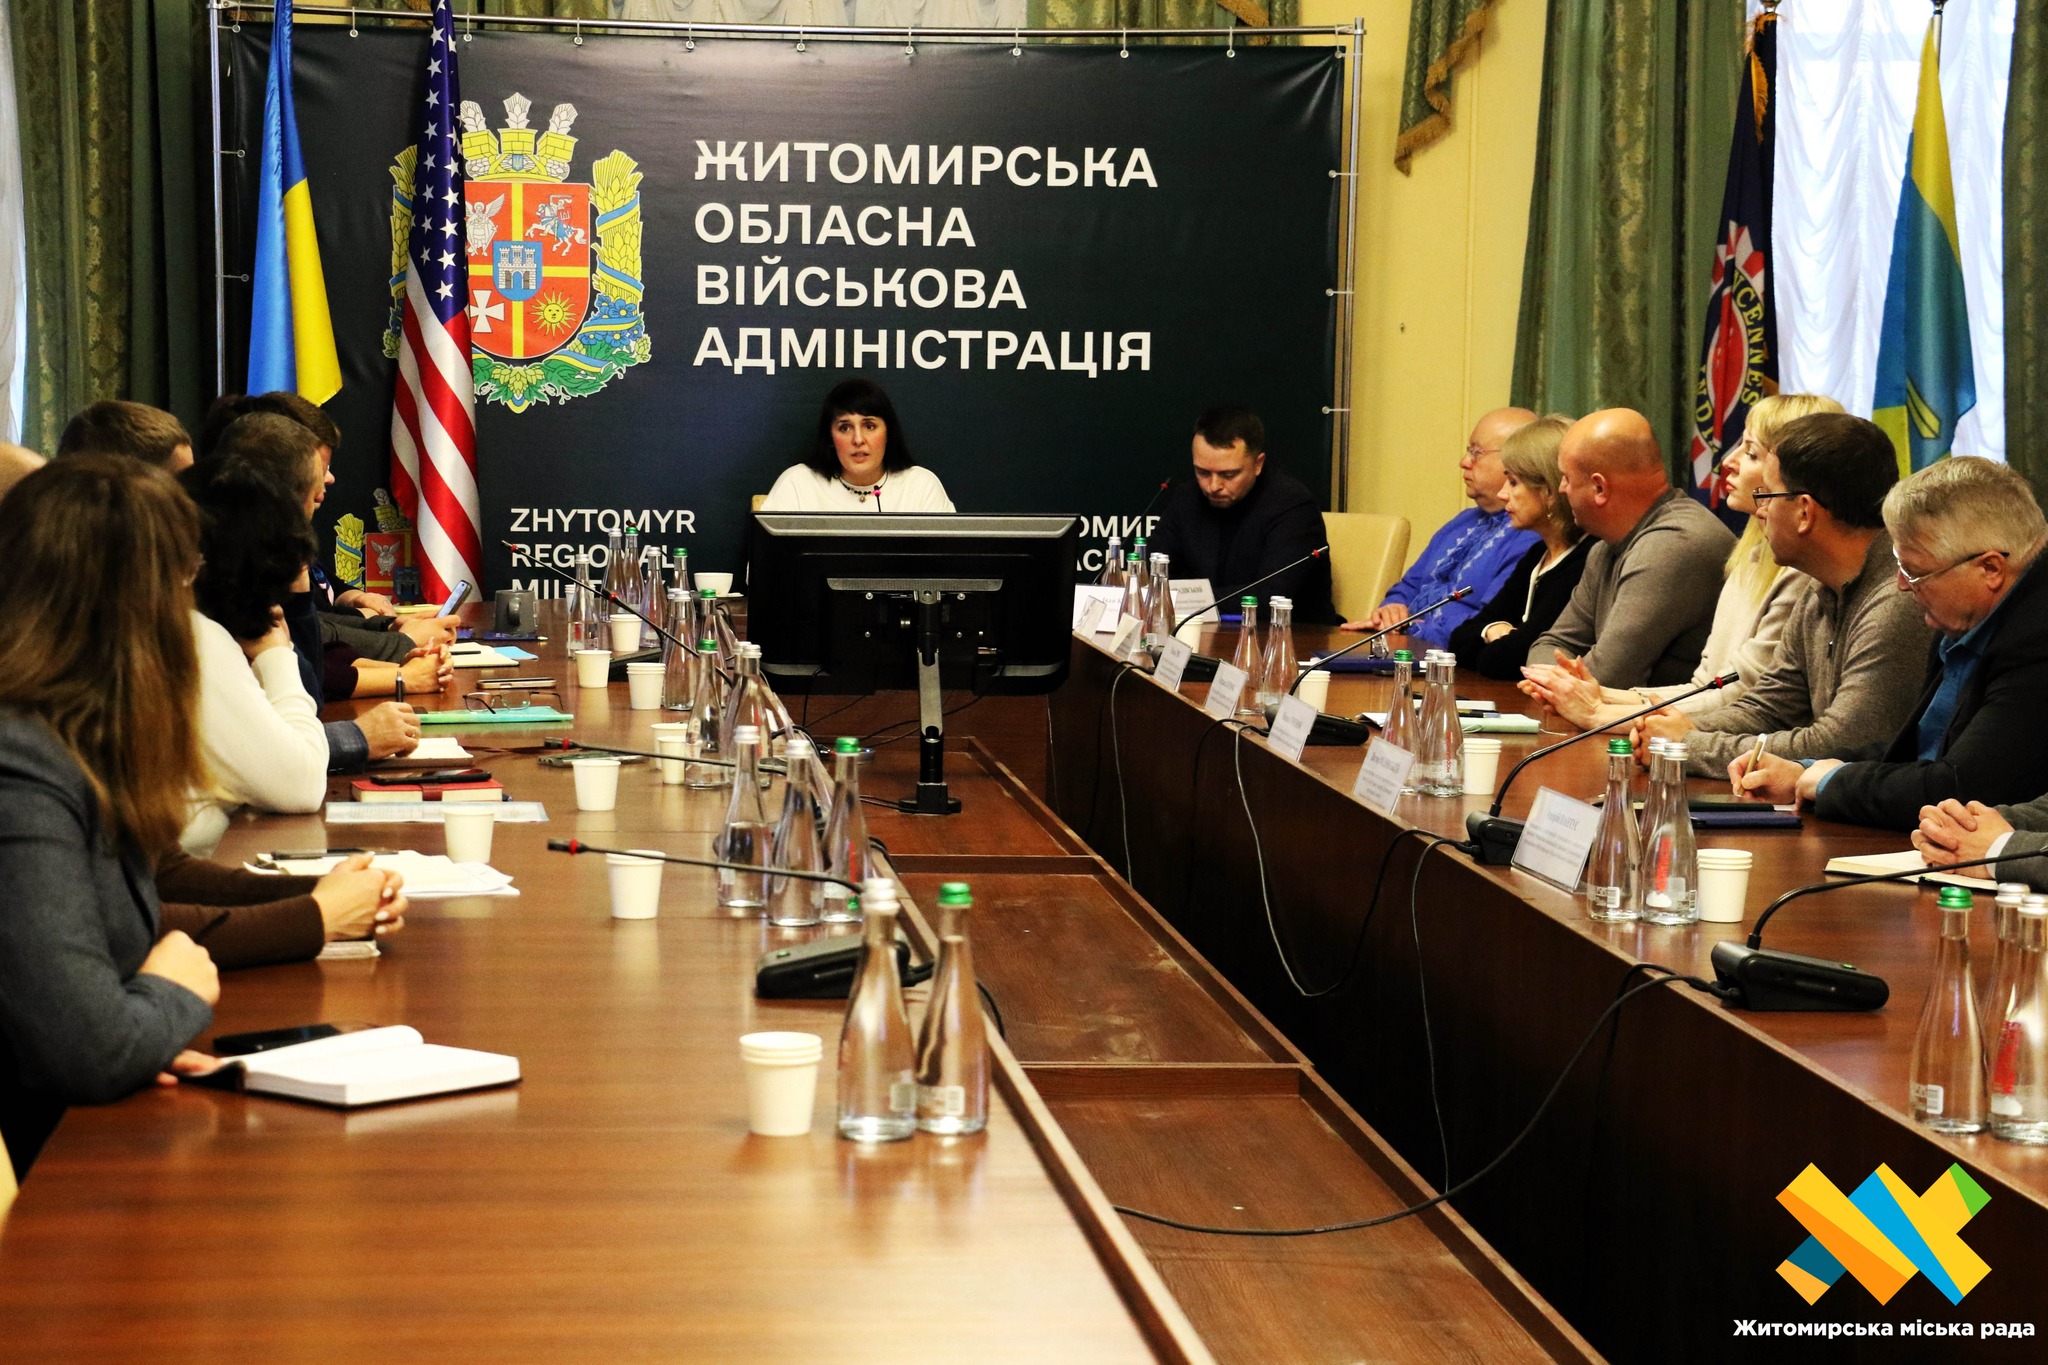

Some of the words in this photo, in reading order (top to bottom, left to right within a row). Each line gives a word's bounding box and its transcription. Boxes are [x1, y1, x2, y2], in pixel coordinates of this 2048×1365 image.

[694, 139, 1159, 188] ЖИТОМИРСЬКА
[694, 202, 977, 248] ОБЛАСНА
[696, 255, 1028, 310] ВІЙСЬКОВА
[692, 326, 1152, 379] АДМІНІСТРАЦІЯ
[509, 507, 697, 534] ZHYTOMYR
